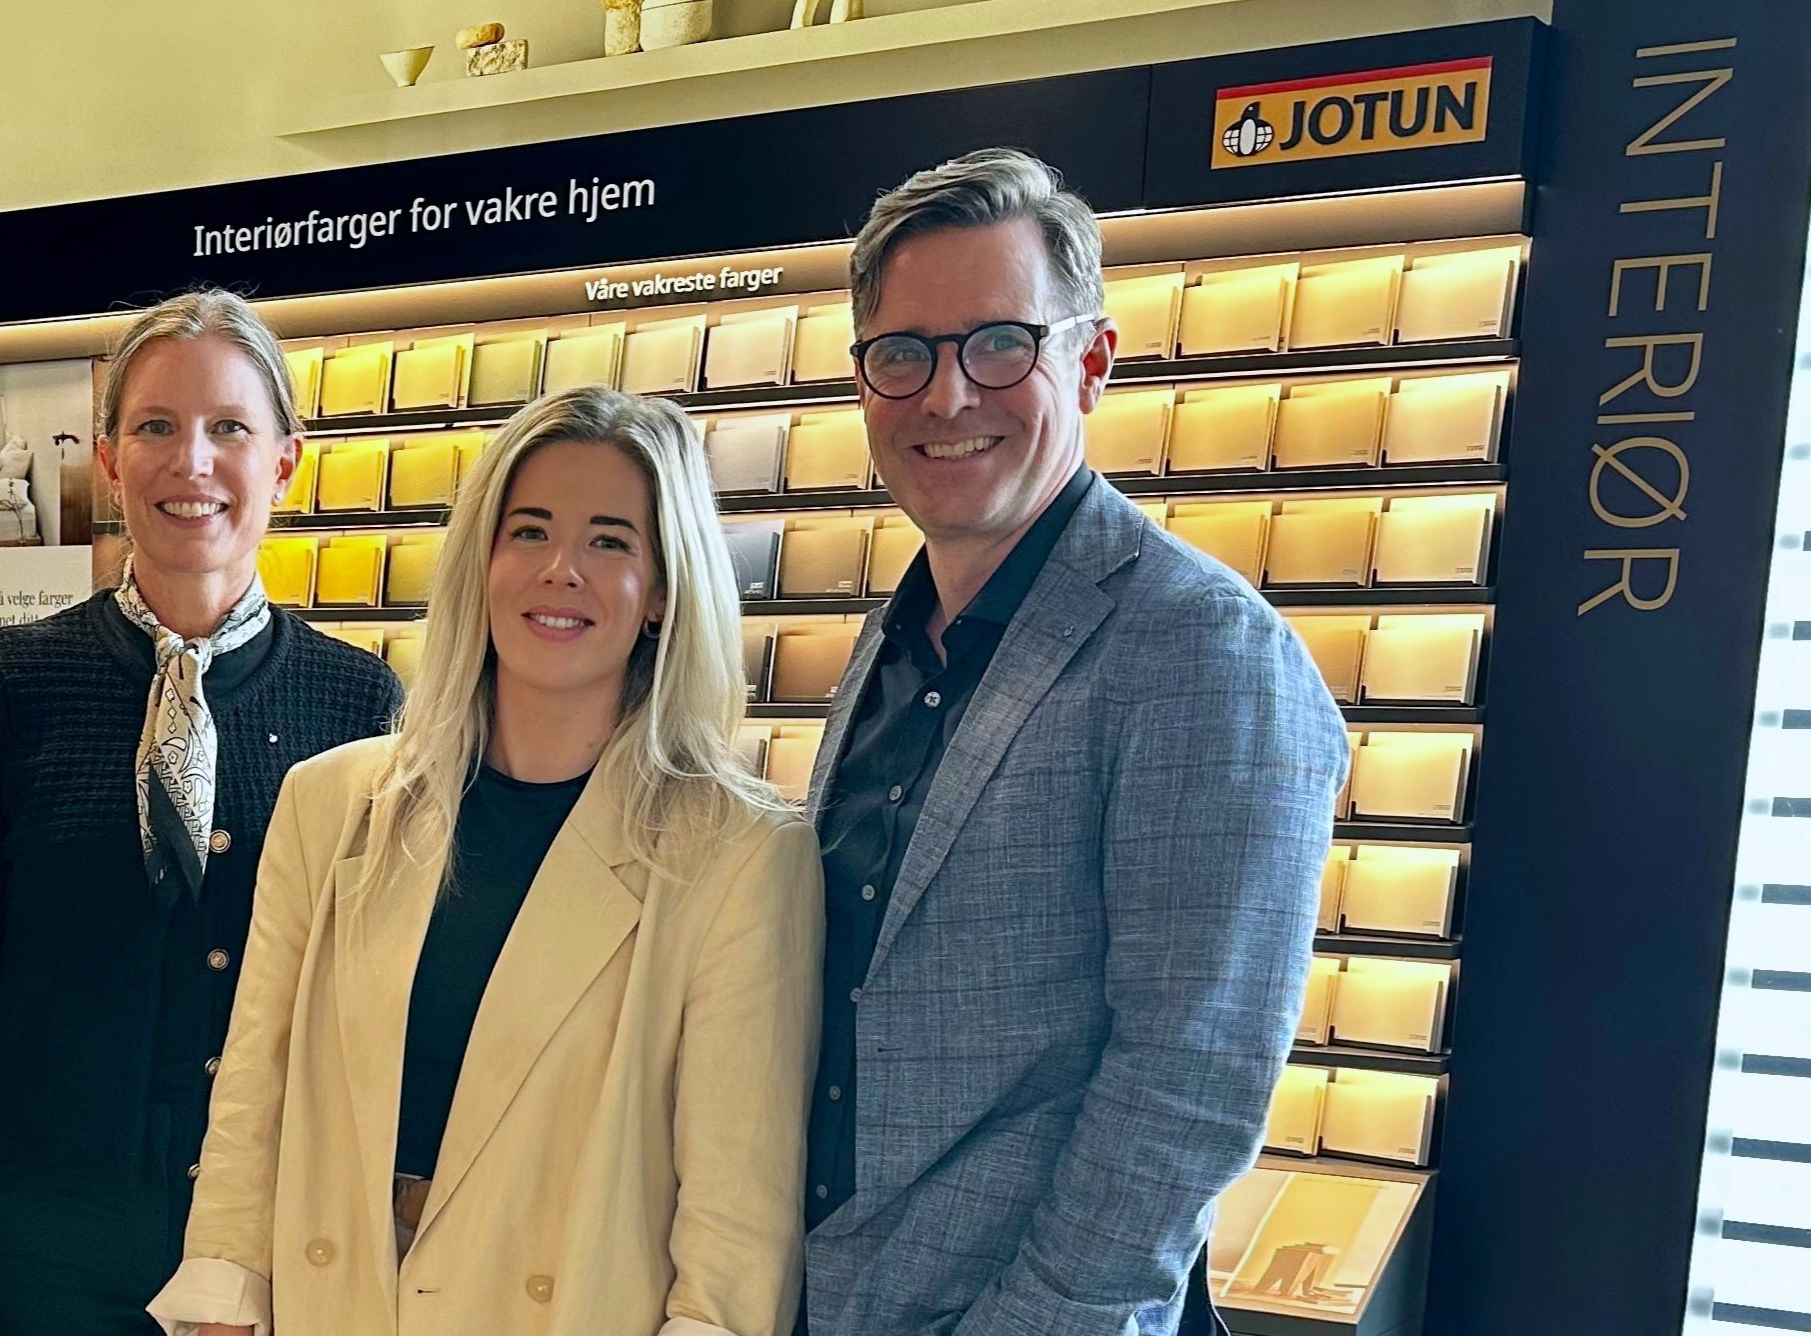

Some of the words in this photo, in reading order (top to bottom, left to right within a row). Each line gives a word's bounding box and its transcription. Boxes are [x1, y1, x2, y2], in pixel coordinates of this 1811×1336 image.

[1280, 81, 1478, 151] JOTUN
[193, 206, 402, 257] Interiørfarger
[409, 198, 456, 232] for
[466, 187, 557, 227] vakre
[567, 175, 656, 224] hjem
[585, 274, 629, 301] Våre
[632, 268, 716, 299] vakreste
[719, 262, 783, 294] farger
[1578, 37, 1738, 617] INTERIØR
[7, 590, 35, 608] velge
[38, 590, 74, 609] farger
